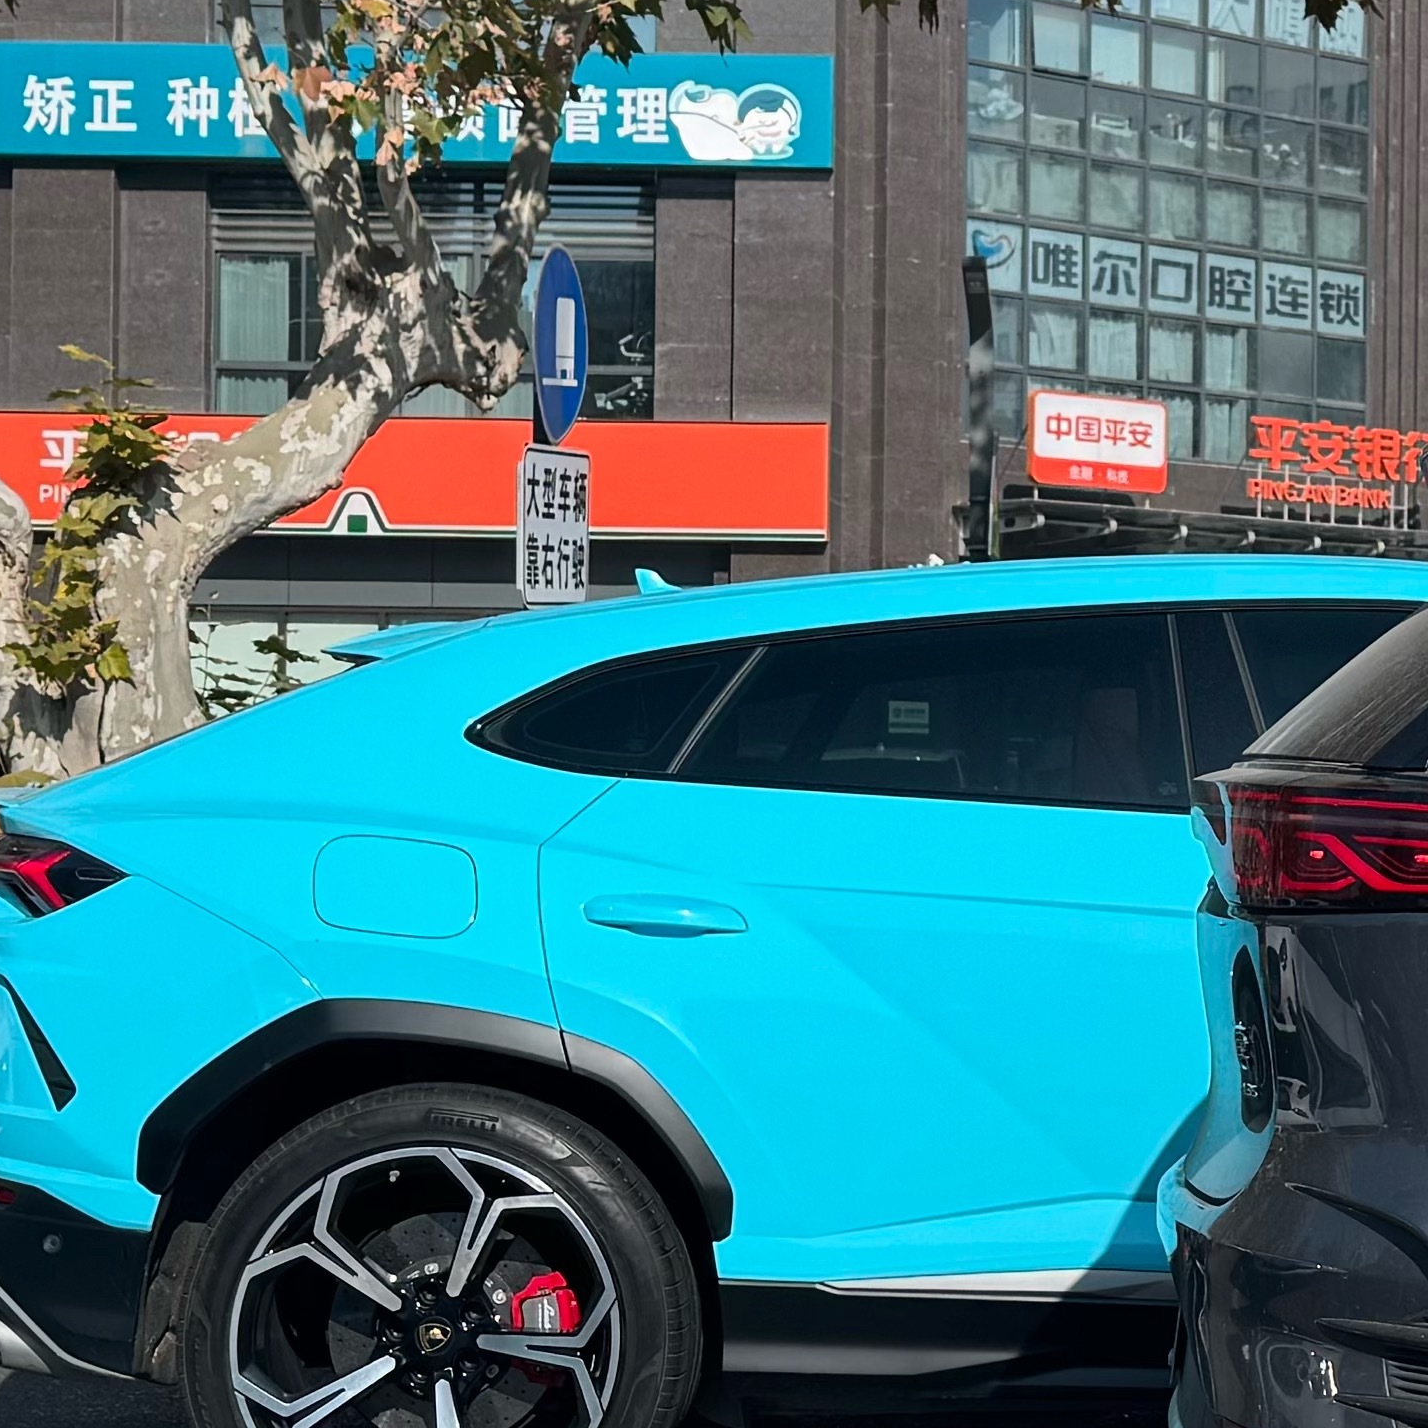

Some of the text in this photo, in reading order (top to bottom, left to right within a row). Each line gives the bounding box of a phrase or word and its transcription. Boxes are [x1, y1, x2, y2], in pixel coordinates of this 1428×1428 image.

[23, 75, 137, 136] 矫正
[1031, 240, 1361, 327] 唯尔口腔连锁
[1046, 413, 1153, 449] 中国平安
[527, 463, 587, 523] 大型车辆
[1247, 478, 1299, 502] PING
[1335, 485, 1392, 509] BANK
[526, 532, 585, 590] 靠右行驶
